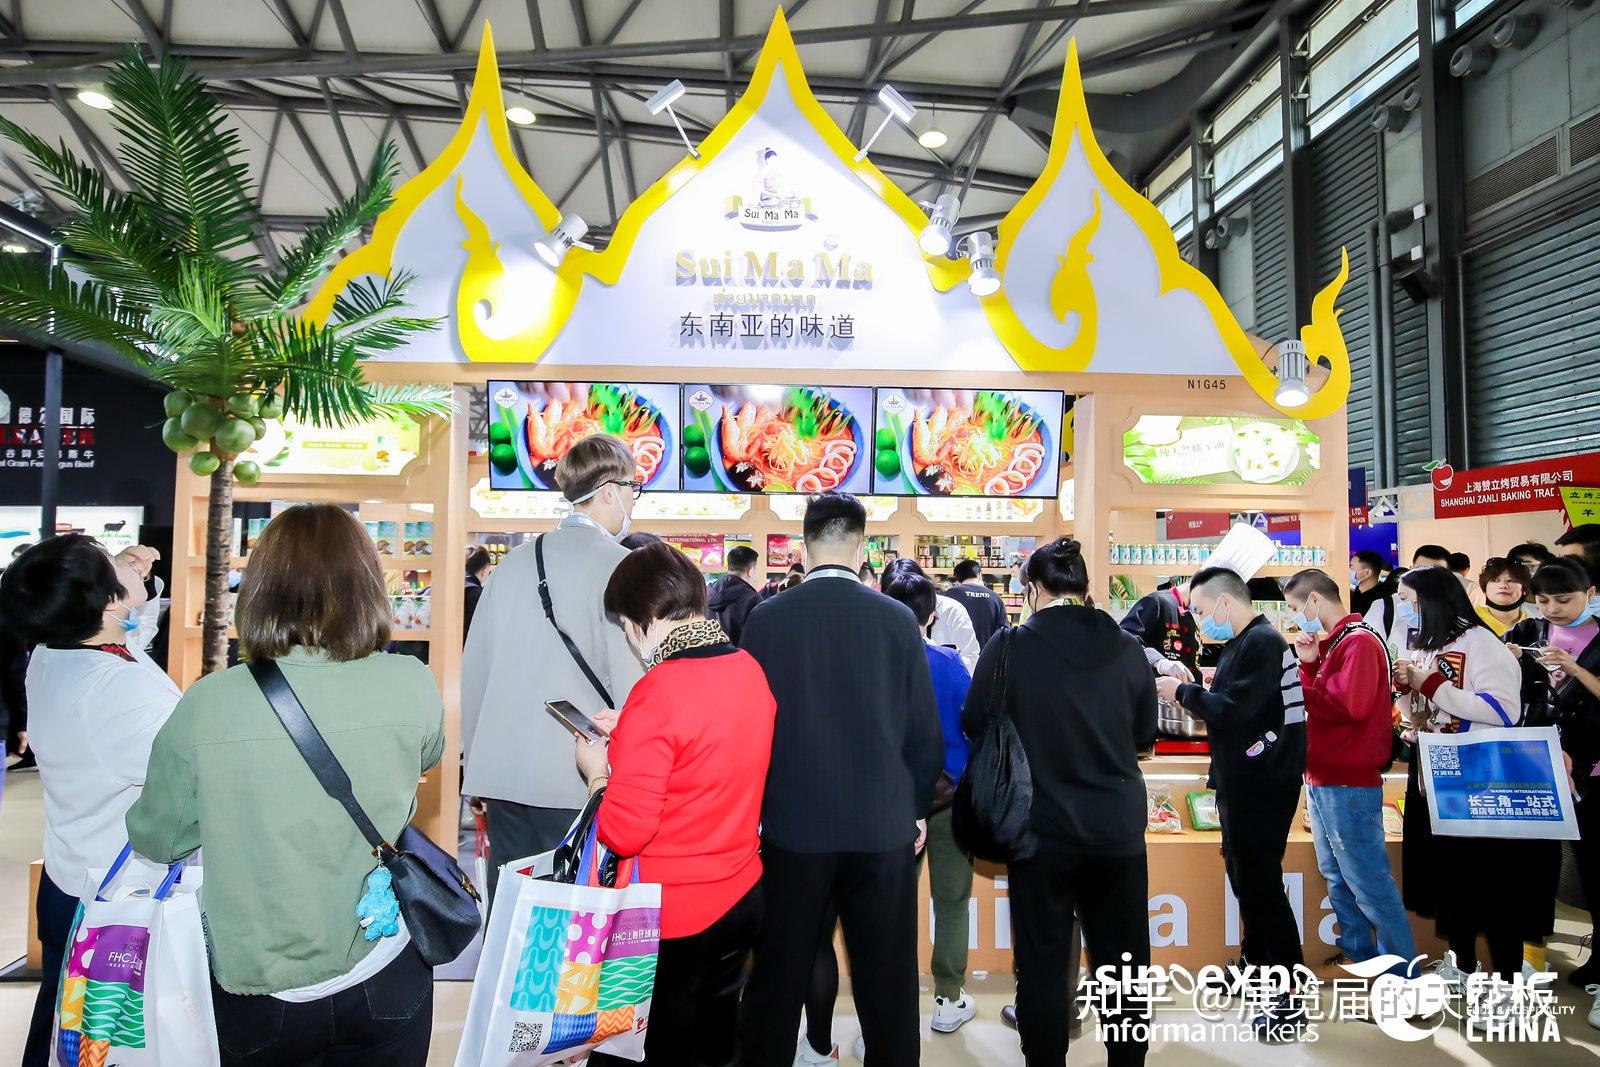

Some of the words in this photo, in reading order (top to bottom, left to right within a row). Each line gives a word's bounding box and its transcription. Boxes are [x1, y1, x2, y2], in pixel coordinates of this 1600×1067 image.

[744, 208, 760, 219] Sui
[764, 210, 779, 220] Ma
[784, 209, 799, 219] Ma
[675, 250, 734, 279] Sui
[744, 252, 805, 280] Ma
[814, 252, 874, 282] Ma
[680, 312, 855, 339] 东南亚的味道
[1187, 379, 1226, 390] N1G45
[1440, 495, 1476, 508] SHANGHAI
[1477, 490, 1499, 504] ZANLI
[1501, 487, 1531, 502] BAKING
[1467, 794, 1557, 809] 长三角一站式
[1469, 806, 1560, 817] 酒店餐饮用品采购基地
